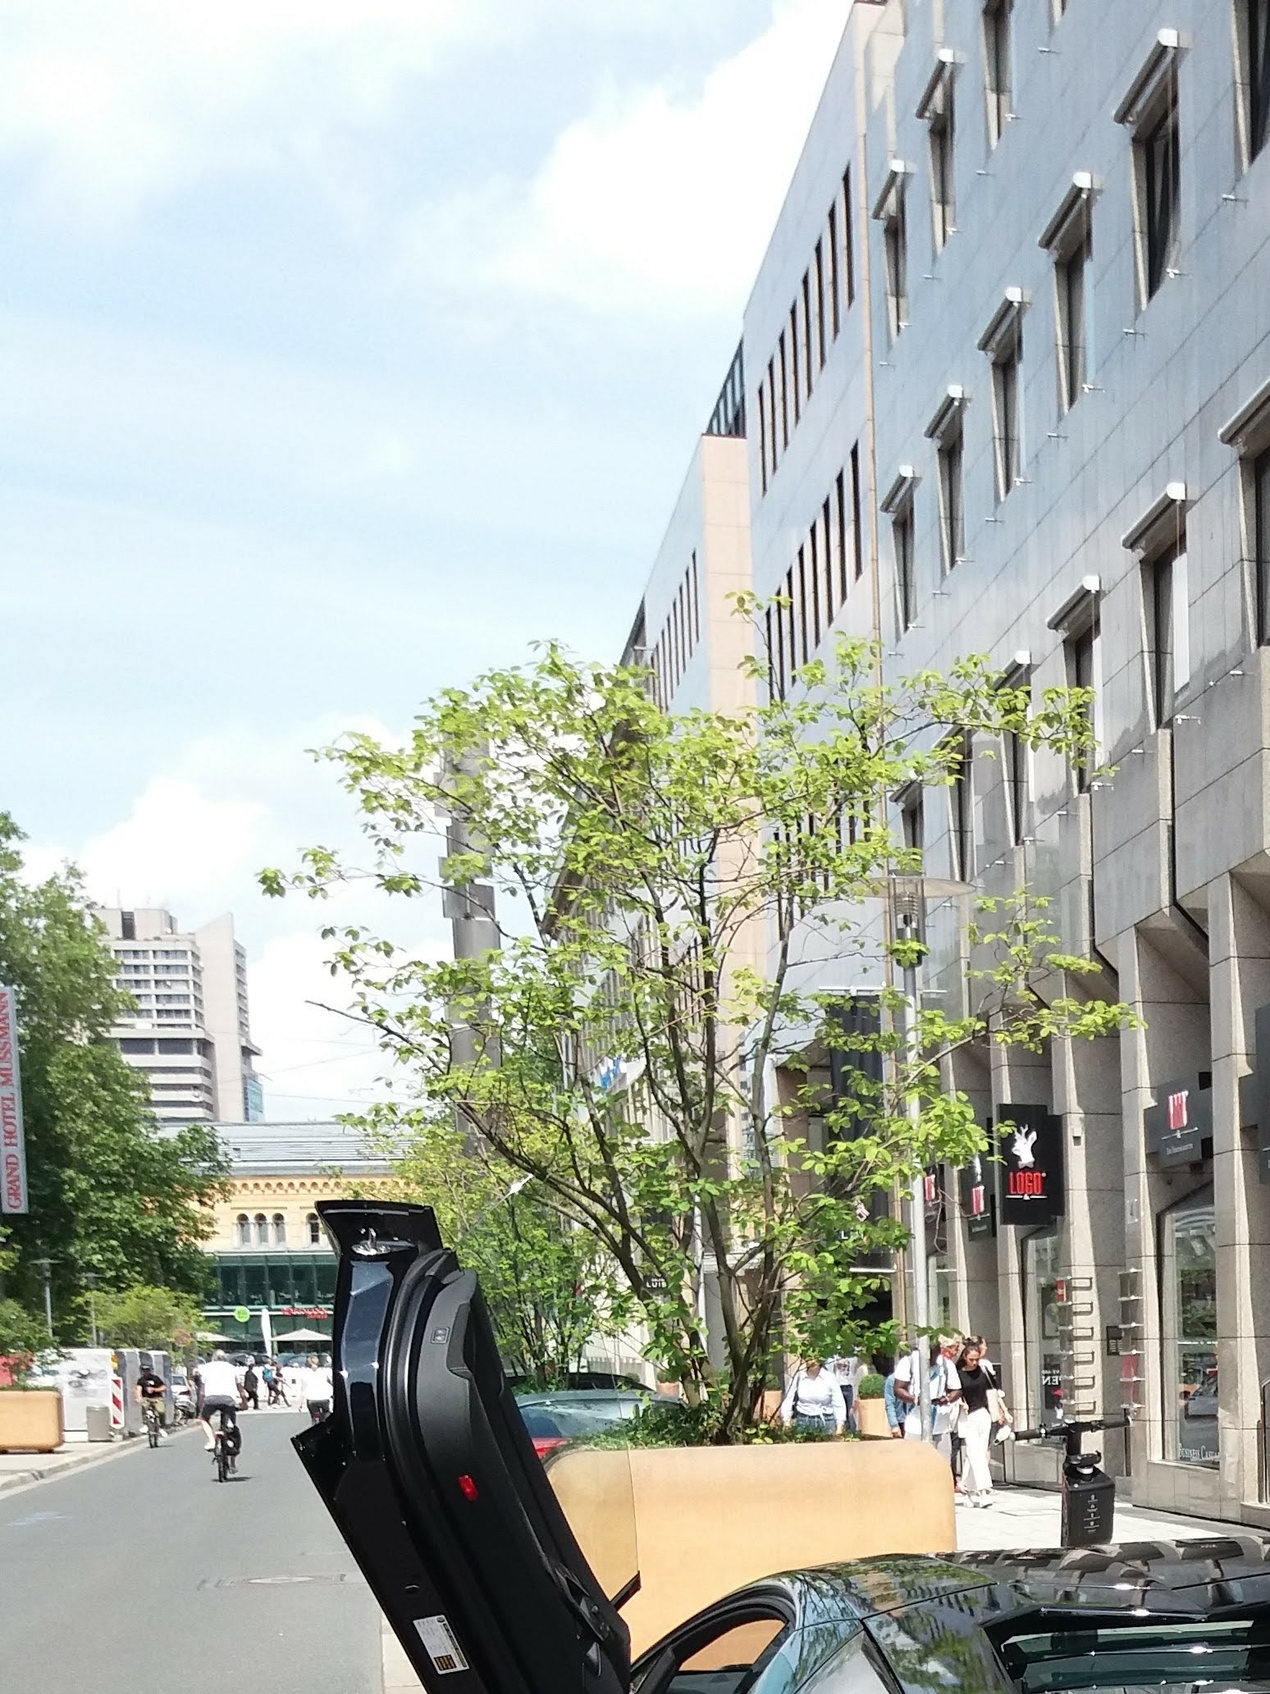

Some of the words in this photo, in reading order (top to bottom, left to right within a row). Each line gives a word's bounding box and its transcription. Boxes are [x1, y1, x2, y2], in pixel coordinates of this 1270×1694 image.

[2, 1092, 18, 1149] HOTEL
[5, 1153, 23, 1210] GRAND
[1008, 1171, 1043, 1195] LOGO
